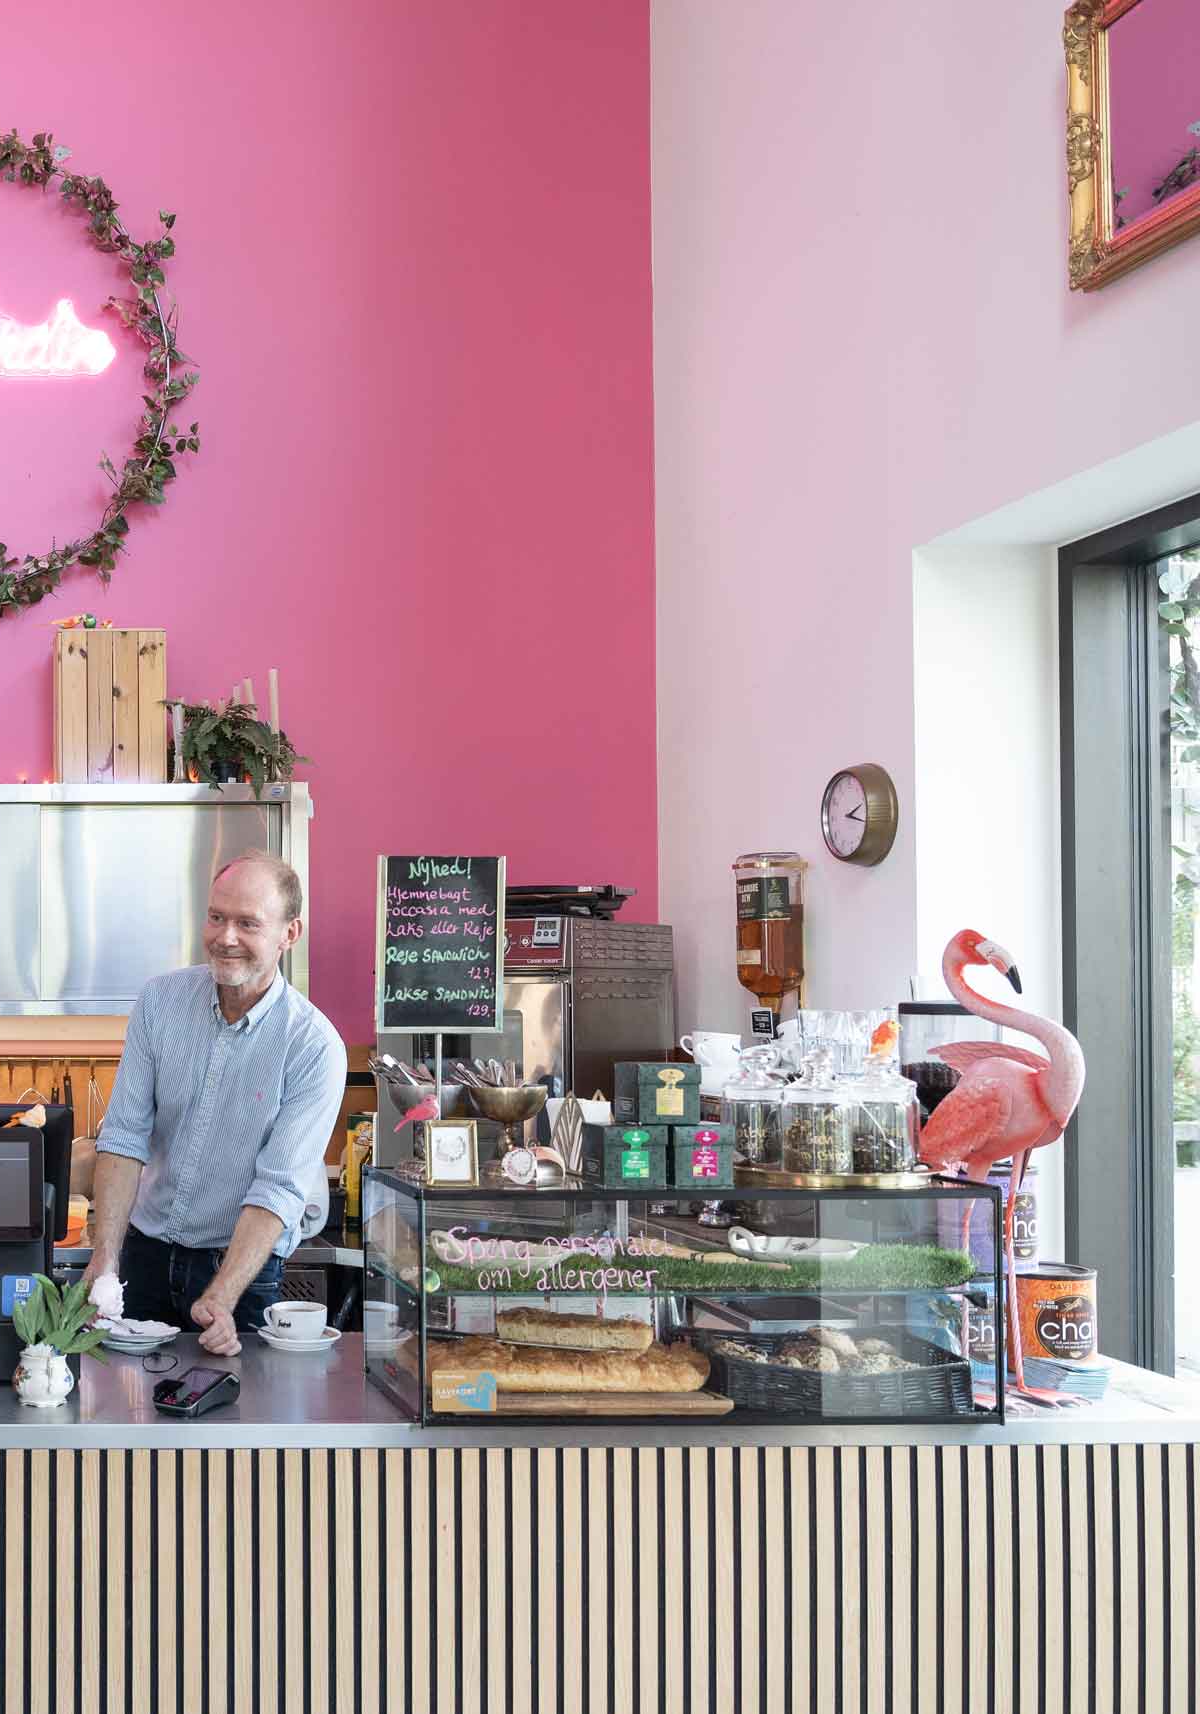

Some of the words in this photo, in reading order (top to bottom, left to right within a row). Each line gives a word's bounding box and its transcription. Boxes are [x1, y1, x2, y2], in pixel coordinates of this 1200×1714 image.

[408, 856, 472, 886] Nyhed!
[458, 903, 496, 917] med
[386, 921, 425, 938] Laks
[430, 920, 459, 936] eller
[463, 921, 495, 943] Reje
[386, 946, 419, 966] Reje
[384, 984, 429, 1003] Lakse
[478, 1267, 512, 1290] om
[536, 1262, 660, 1304] allergener
[1040, 1313, 1096, 1341] chai
